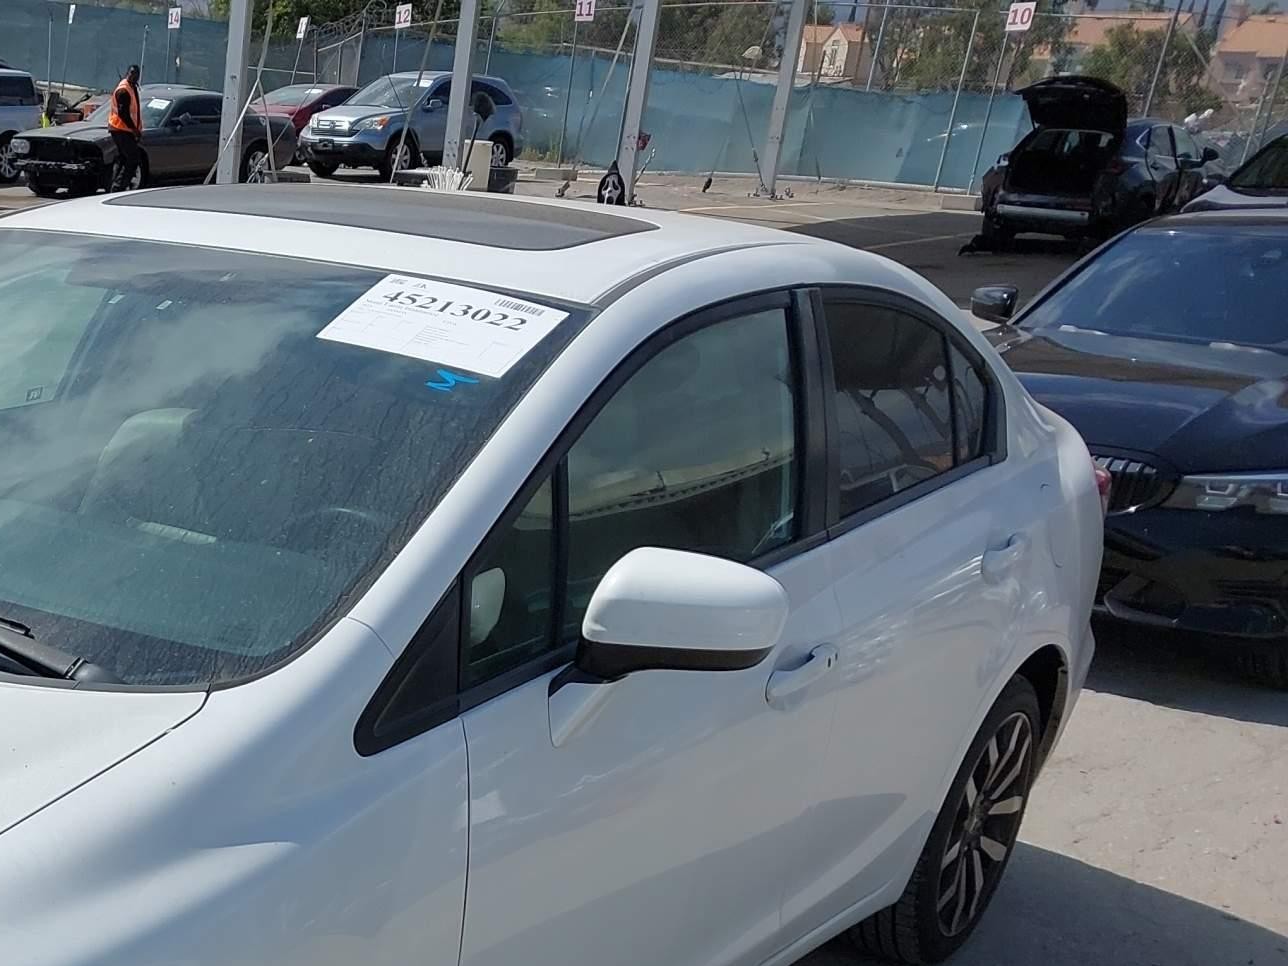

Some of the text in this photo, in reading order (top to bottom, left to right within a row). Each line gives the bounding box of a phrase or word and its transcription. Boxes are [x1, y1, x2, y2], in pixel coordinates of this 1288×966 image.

[396, 9, 410, 24] 12
[576, 1, 593, 17] 11
[1008, 8, 1032, 25] 10
[169, 11, 180, 25] 14
[382, 290, 527, 331] 45213022
